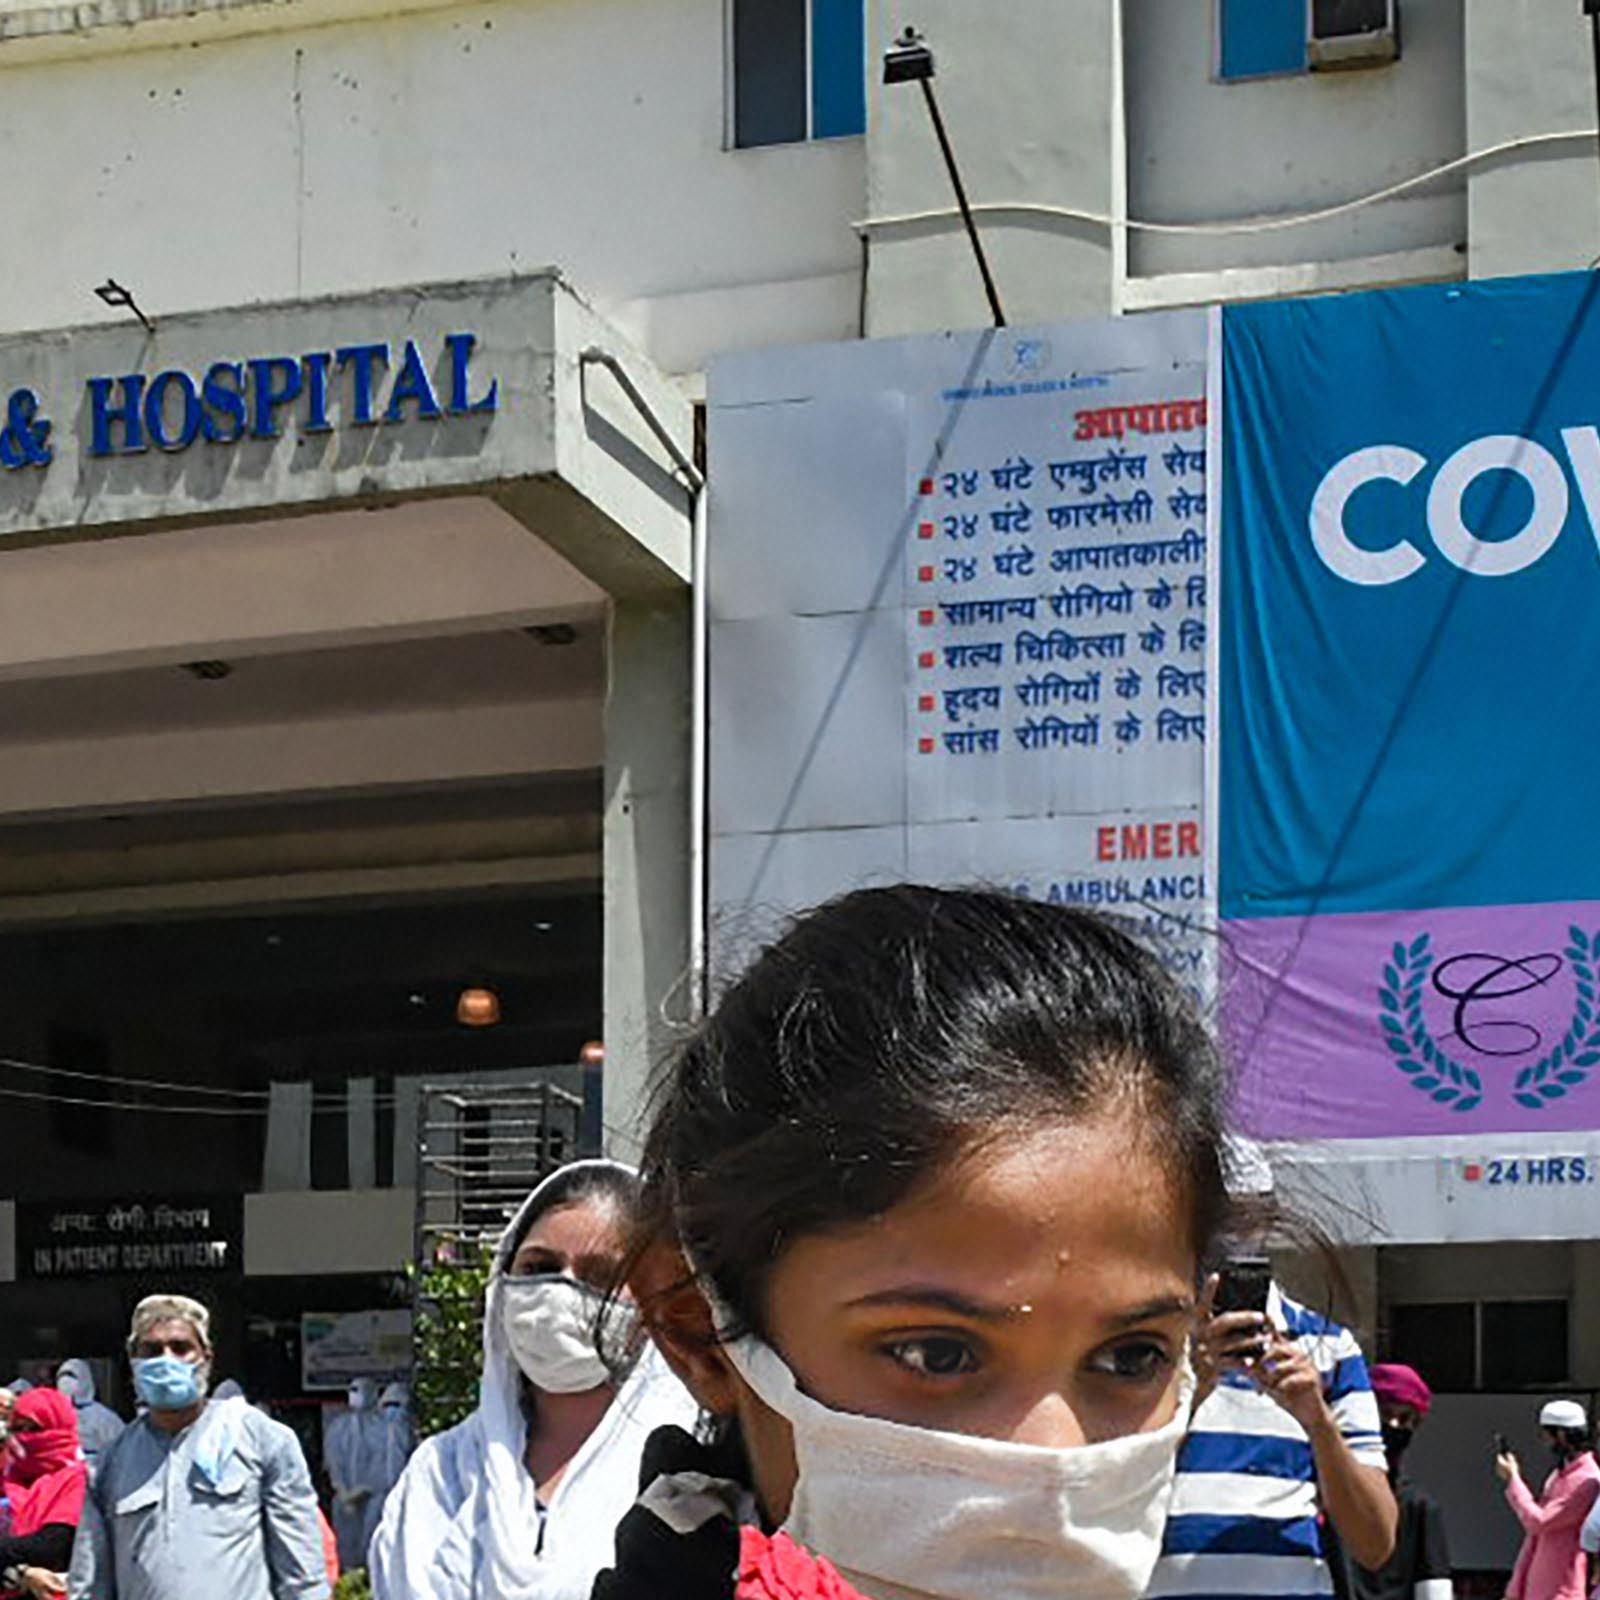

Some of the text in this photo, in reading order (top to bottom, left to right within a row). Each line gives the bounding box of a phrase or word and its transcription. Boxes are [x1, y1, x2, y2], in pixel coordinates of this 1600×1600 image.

[0, 388, 55, 471] &
[86, 333, 499, 457] HOSPITAL
[942, 470, 979, 499] २४
[943, 513, 979, 541] २४
[943, 557, 977, 585] २४
[1145, 577, 1172, 611] के
[1138, 620, 1166, 655] के
[1115, 709, 1142, 744] के
[1488, 1160, 1521, 1184] 24
[1527, 1156, 1594, 1184] HRS.
[122, 1240, 228, 1269] DEPARTMENT
